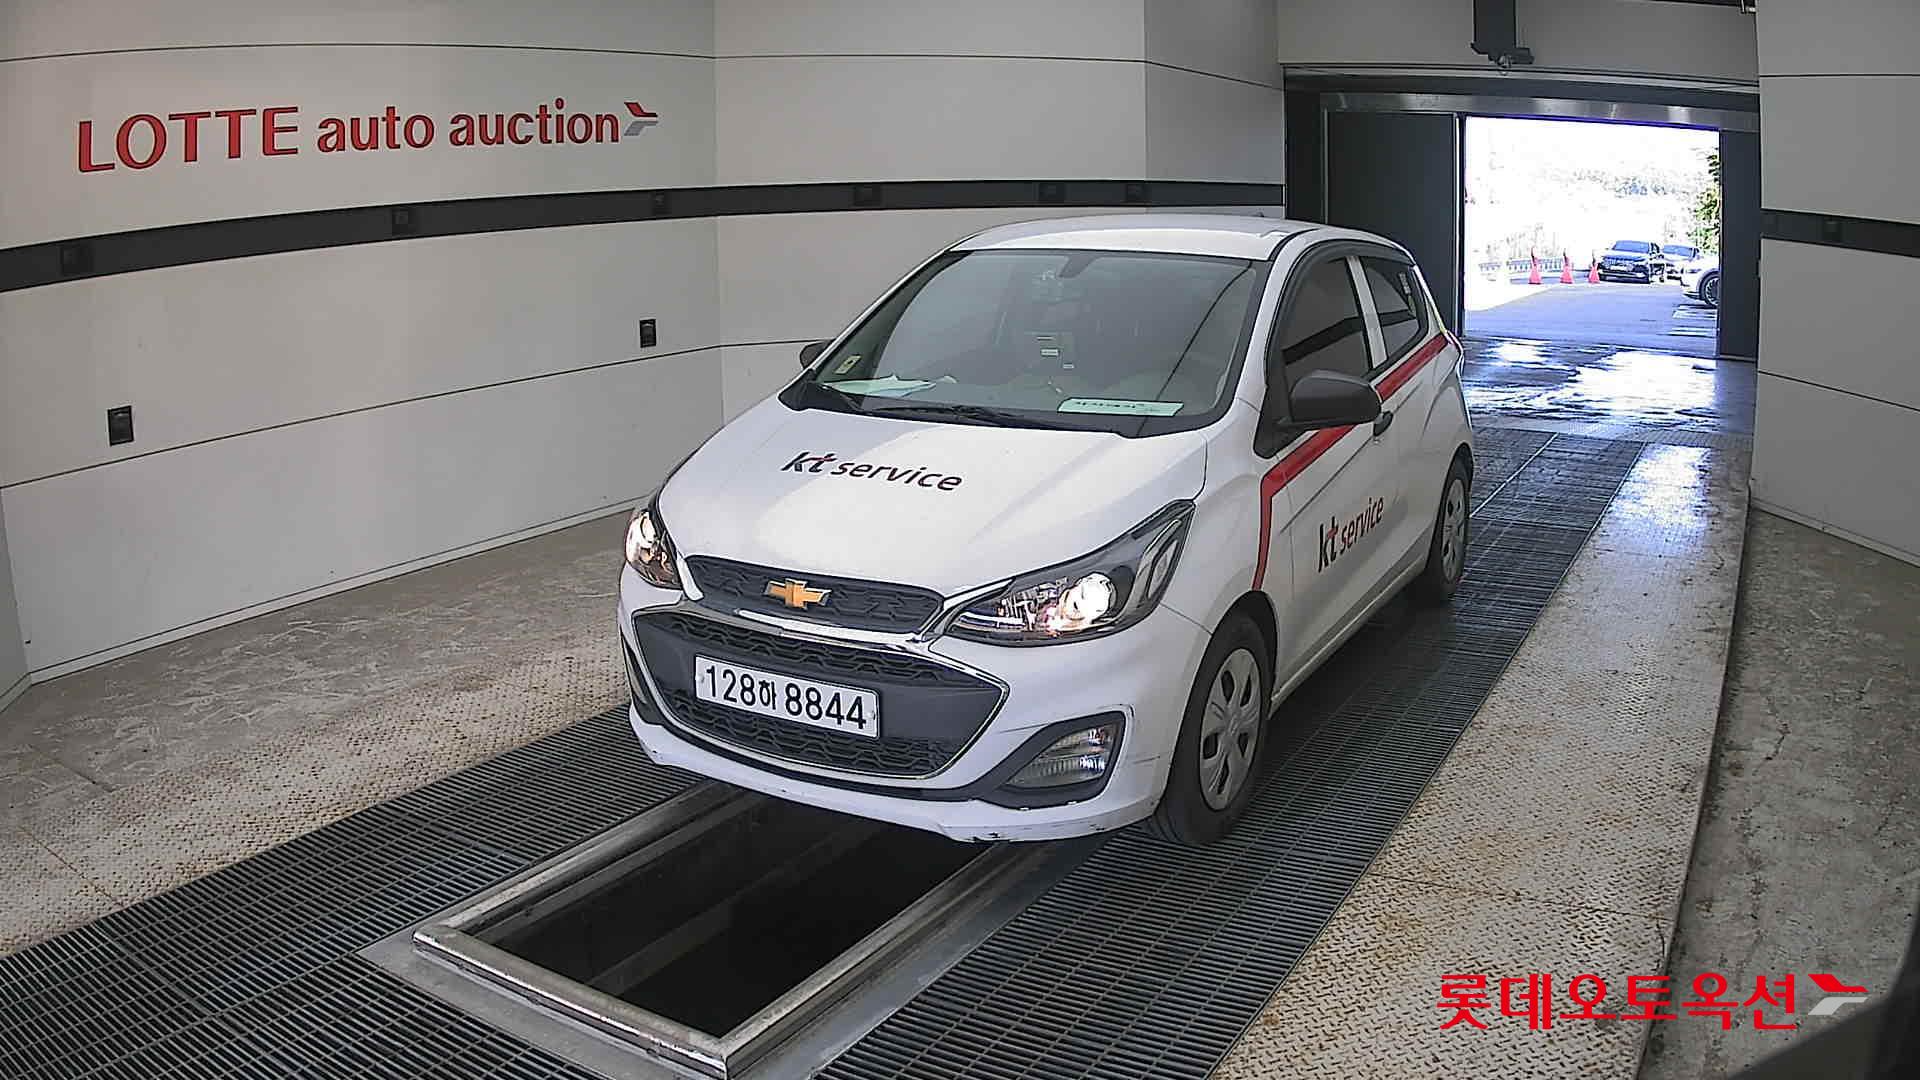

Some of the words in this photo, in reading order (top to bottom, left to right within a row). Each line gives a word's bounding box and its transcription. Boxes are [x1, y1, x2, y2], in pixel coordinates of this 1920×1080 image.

[77, 105, 299, 173] LOTTE
[317, 106, 435, 154] auto
[449, 98, 621, 147] auction
[780, 451, 837, 474] kt
[831, 460, 963, 491] service
[1318, 515, 1339, 574] kt
[1339, 497, 1384, 556] service
